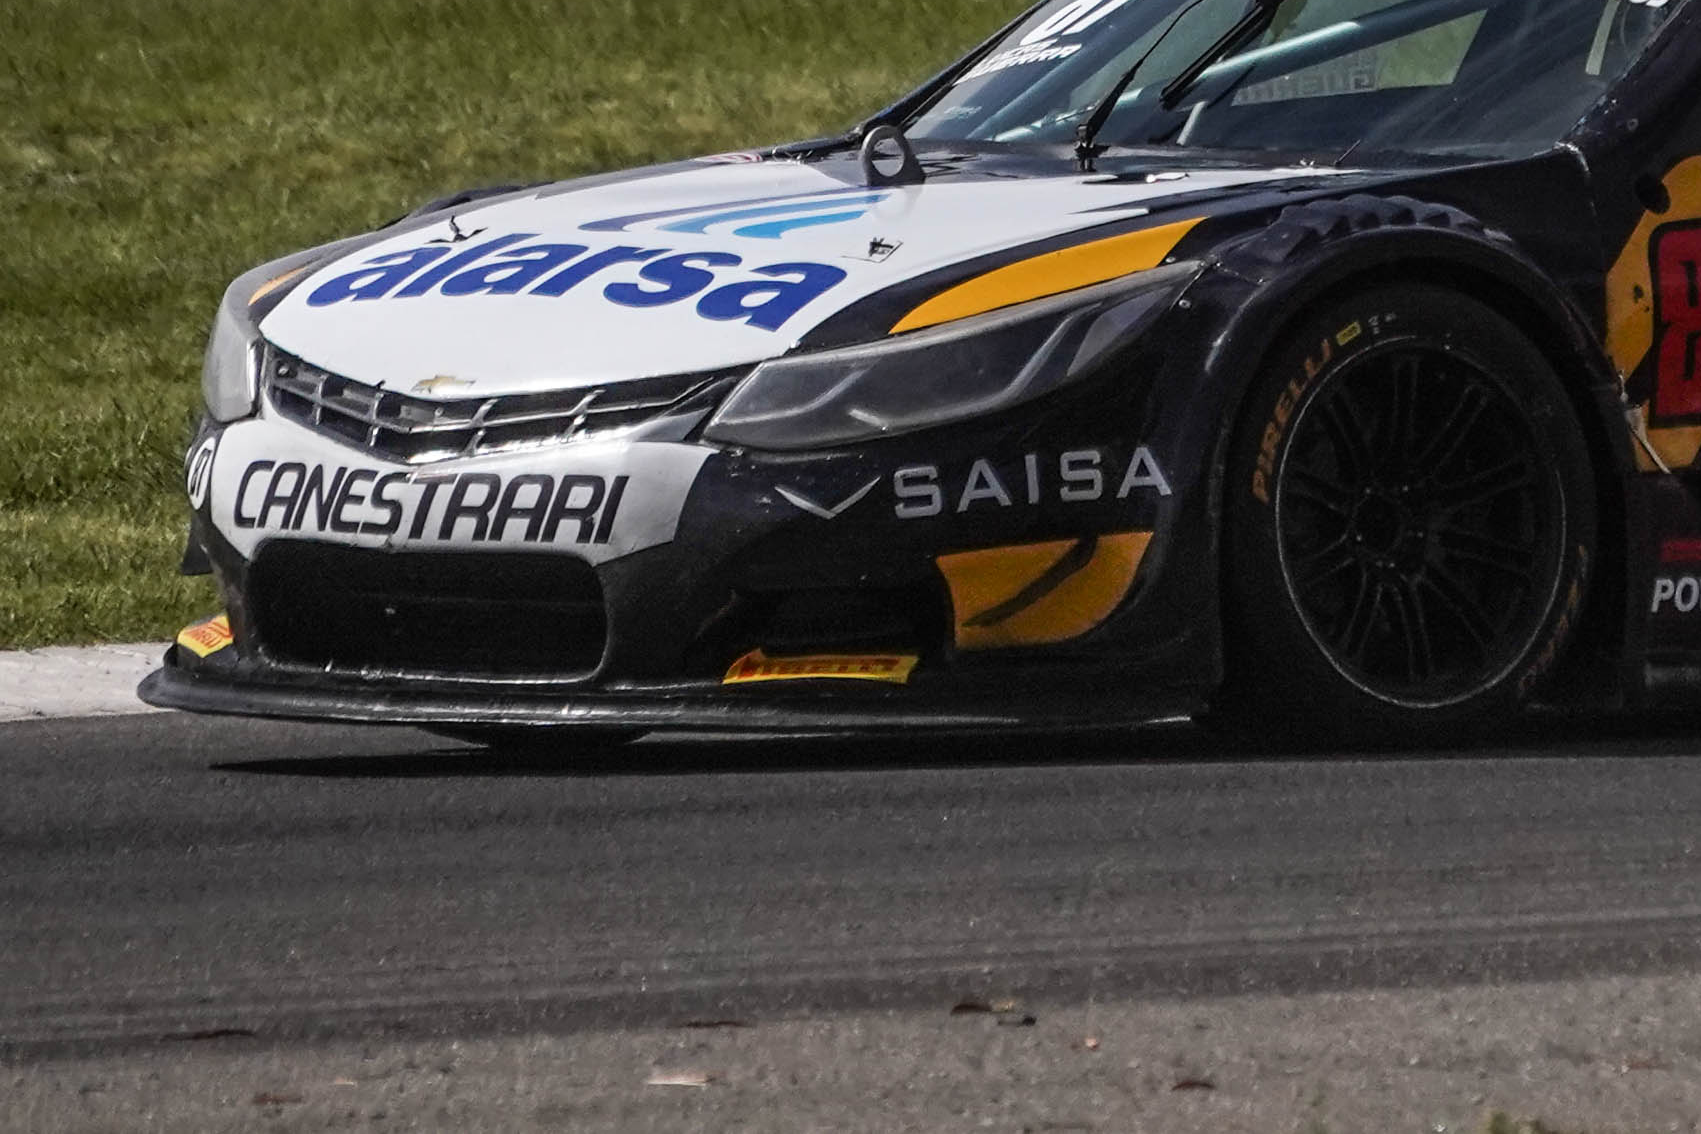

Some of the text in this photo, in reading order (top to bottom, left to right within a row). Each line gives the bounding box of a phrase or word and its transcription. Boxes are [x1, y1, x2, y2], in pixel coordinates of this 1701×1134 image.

[305, 232, 848, 333] alarsa
[233, 459, 630, 545] CANESTRARI
[893, 446, 1173, 519] SAISA
